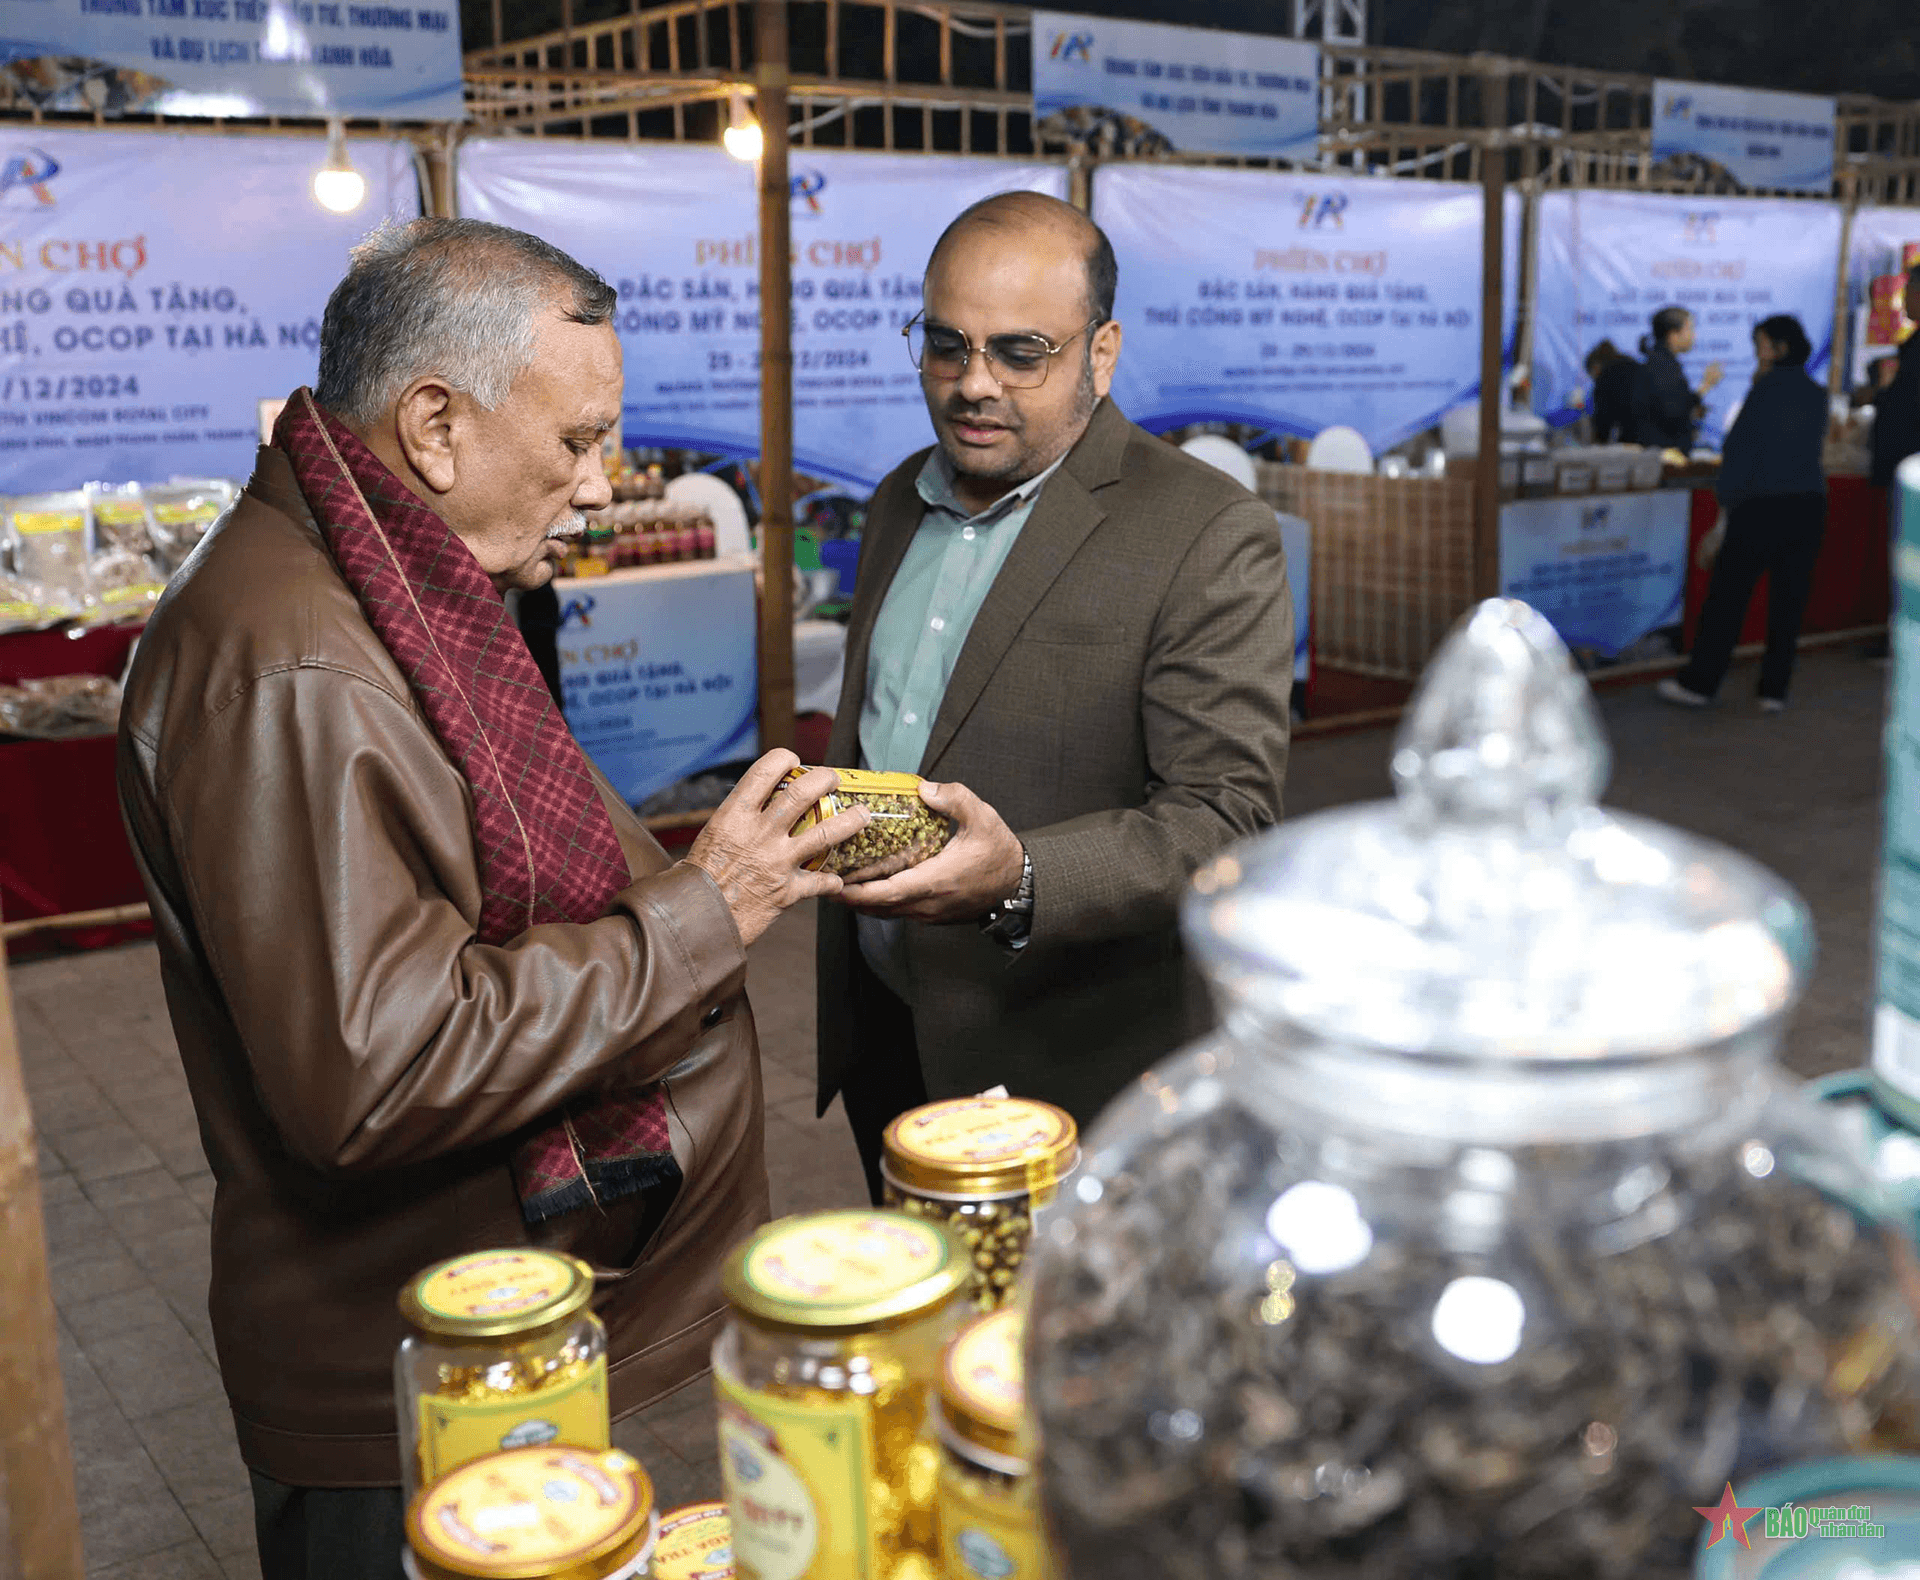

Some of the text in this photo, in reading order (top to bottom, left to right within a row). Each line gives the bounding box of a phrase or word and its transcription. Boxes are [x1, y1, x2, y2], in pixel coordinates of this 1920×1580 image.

[40, 234, 147, 280] CHỢ
[65, 280, 139, 315] QUÀ
[53, 325, 154, 353] OCOP
[164, 324, 214, 357] TẠI
[223, 316, 267, 349] HÀ
[813, 310, 882, 331] OCOP
